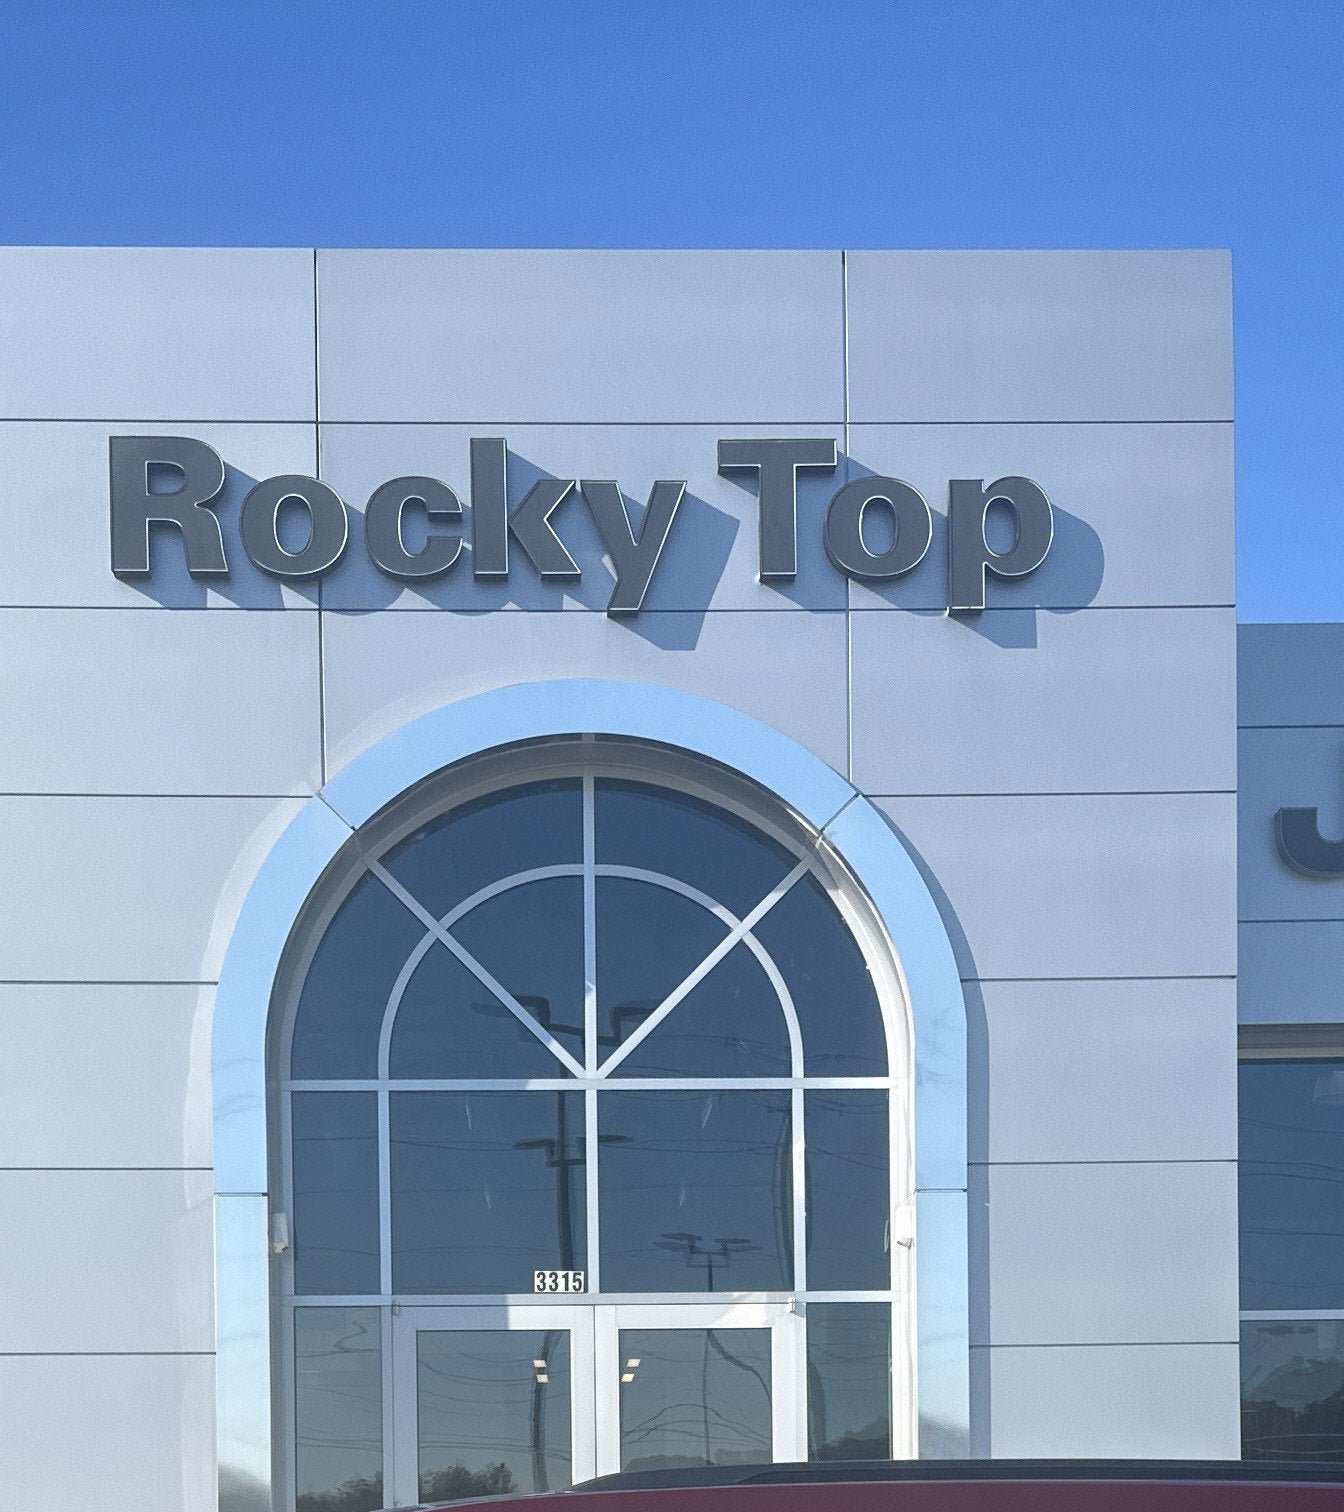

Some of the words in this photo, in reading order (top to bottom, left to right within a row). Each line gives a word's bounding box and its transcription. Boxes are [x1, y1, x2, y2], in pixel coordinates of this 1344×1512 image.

[109, 436, 687, 618] Rocky
[717, 438, 1054, 617] Top
[536, 1271, 582, 1292] 3315
